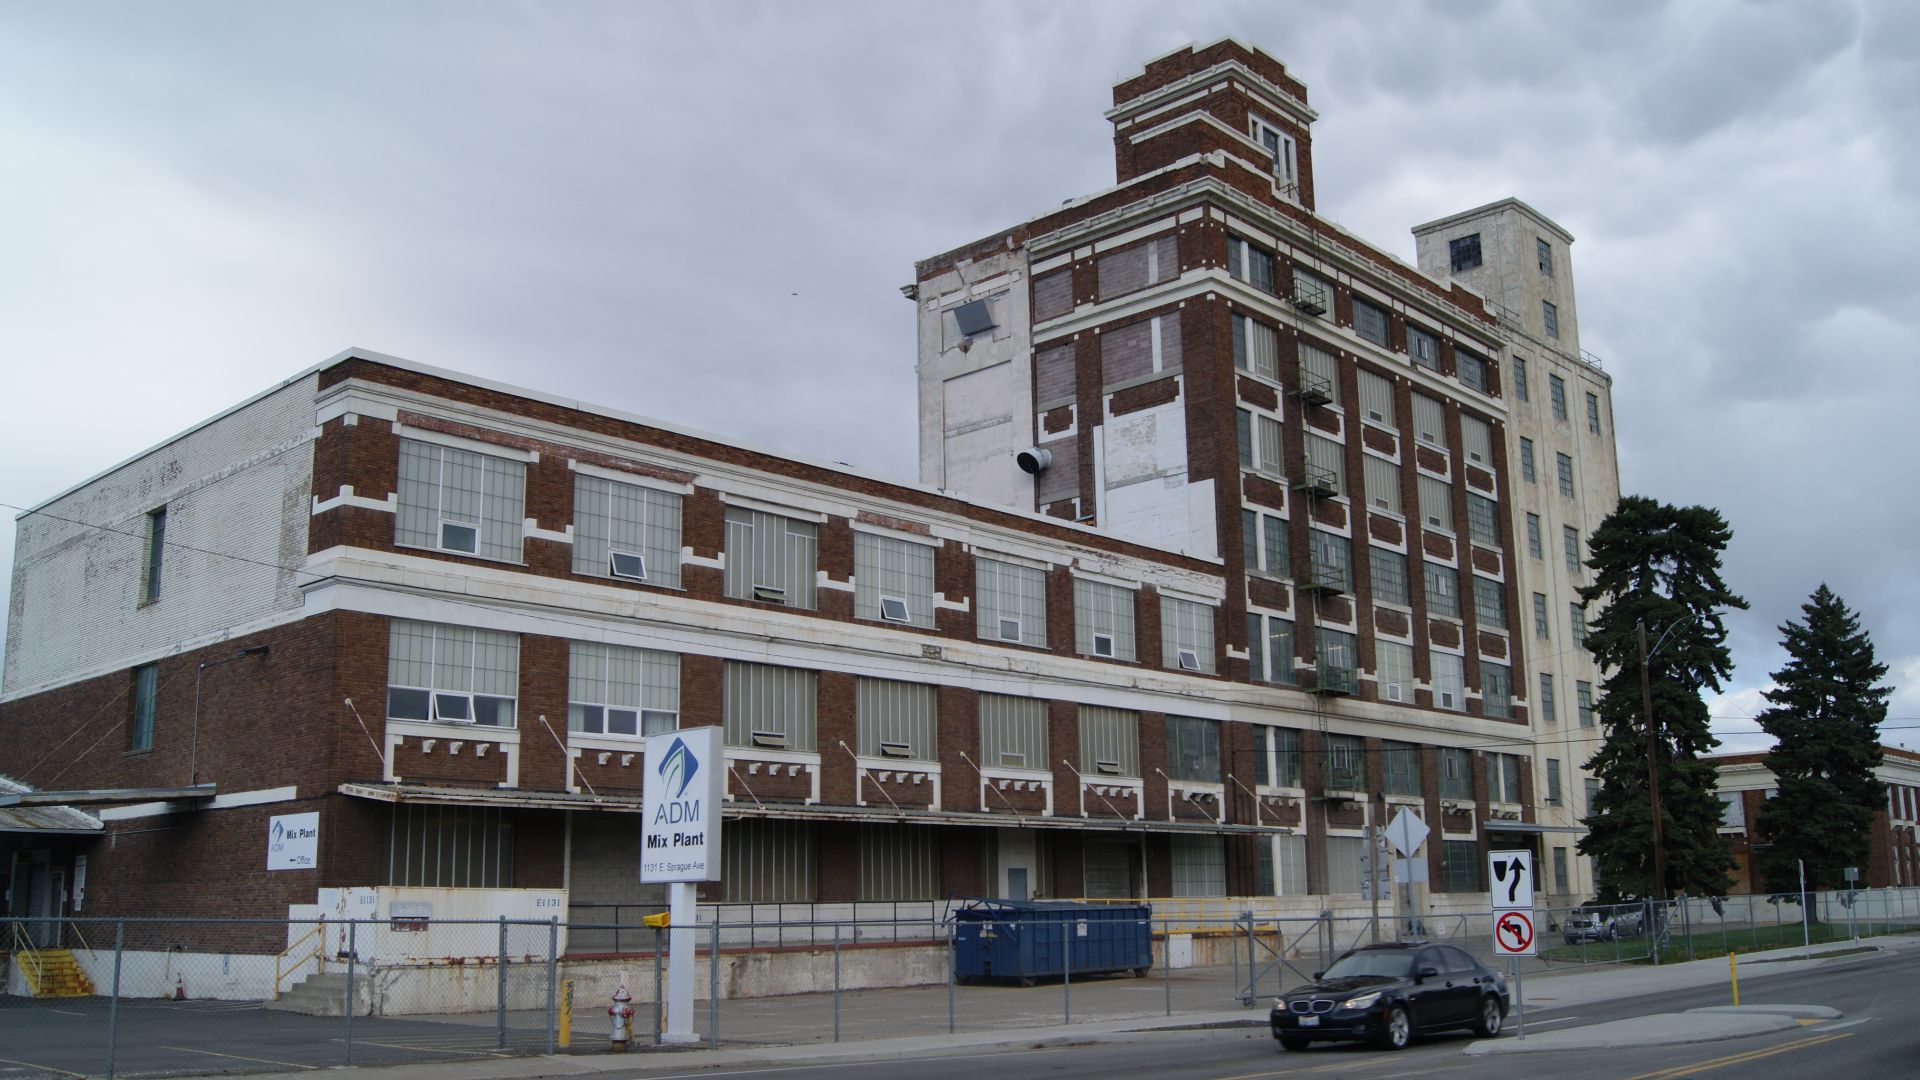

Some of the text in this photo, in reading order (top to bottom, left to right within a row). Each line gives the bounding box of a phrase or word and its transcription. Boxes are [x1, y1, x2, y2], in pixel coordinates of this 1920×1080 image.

[654, 800, 699, 825] ADM
[287, 828, 316, 839] Mix Plant
[647, 832, 704, 849] Mix Plant
[297, 855, 311, 865] Office
[644, 863, 658, 872] 1131
[667, 862, 692, 873] Sprague
[692, 861, 705, 870] Ave
